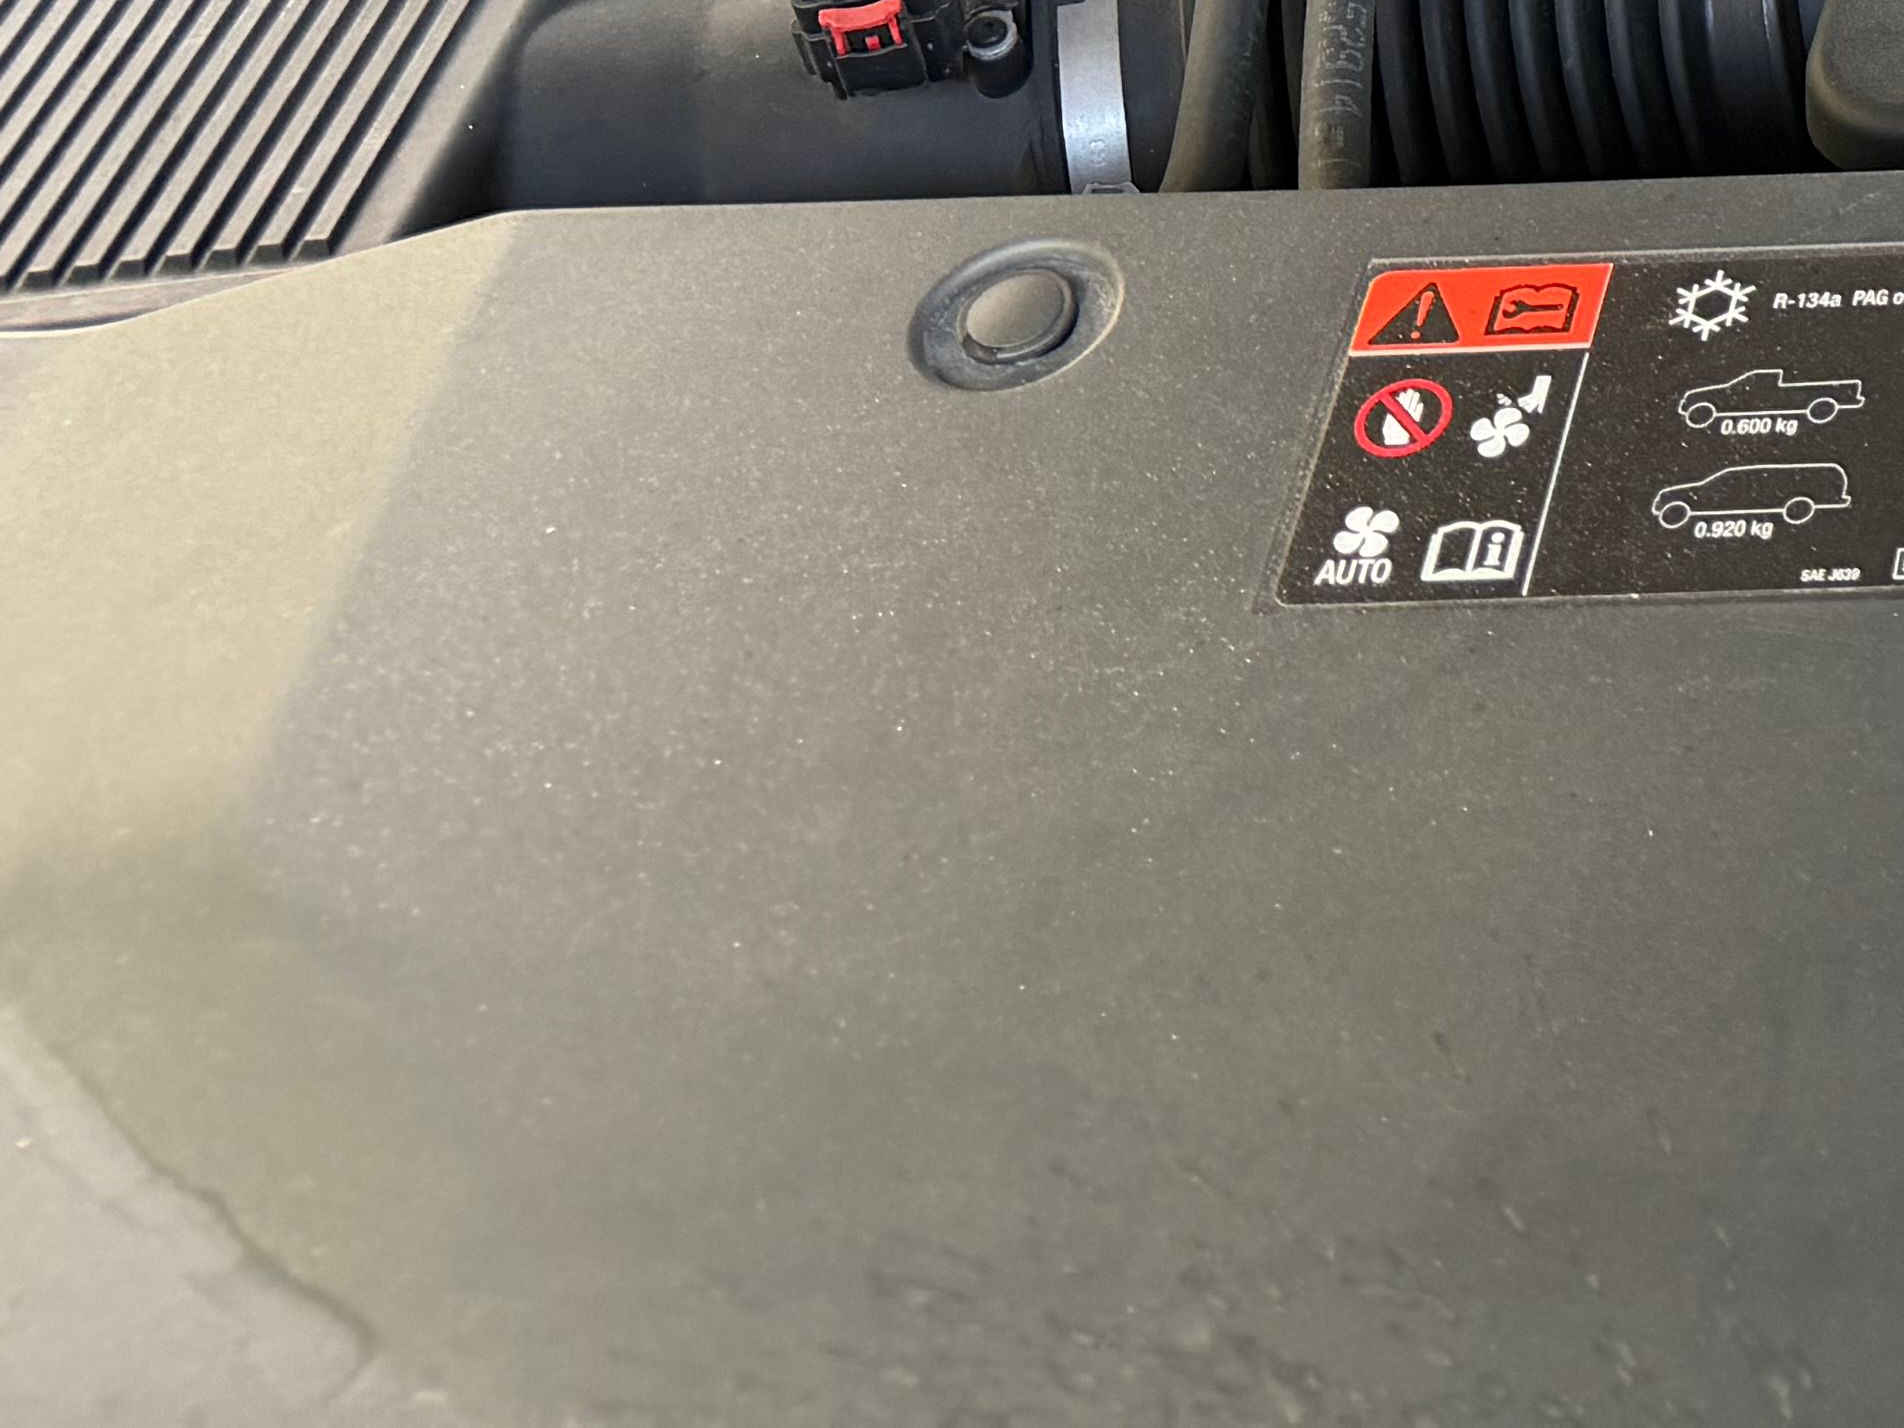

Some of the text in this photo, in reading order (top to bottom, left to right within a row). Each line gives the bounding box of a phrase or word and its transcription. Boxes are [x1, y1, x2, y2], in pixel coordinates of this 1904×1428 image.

[1772, 291, 1842, 310] R-134a
[1851, 289, 1889, 307] PAG
[1720, 417, 1799, 436] 0.600 kg
[1693, 521, 1774, 541] 0.920 kg
[1313, 557, 1393, 586] AUTO
[1799, 568, 1861, 583] SAE J639
